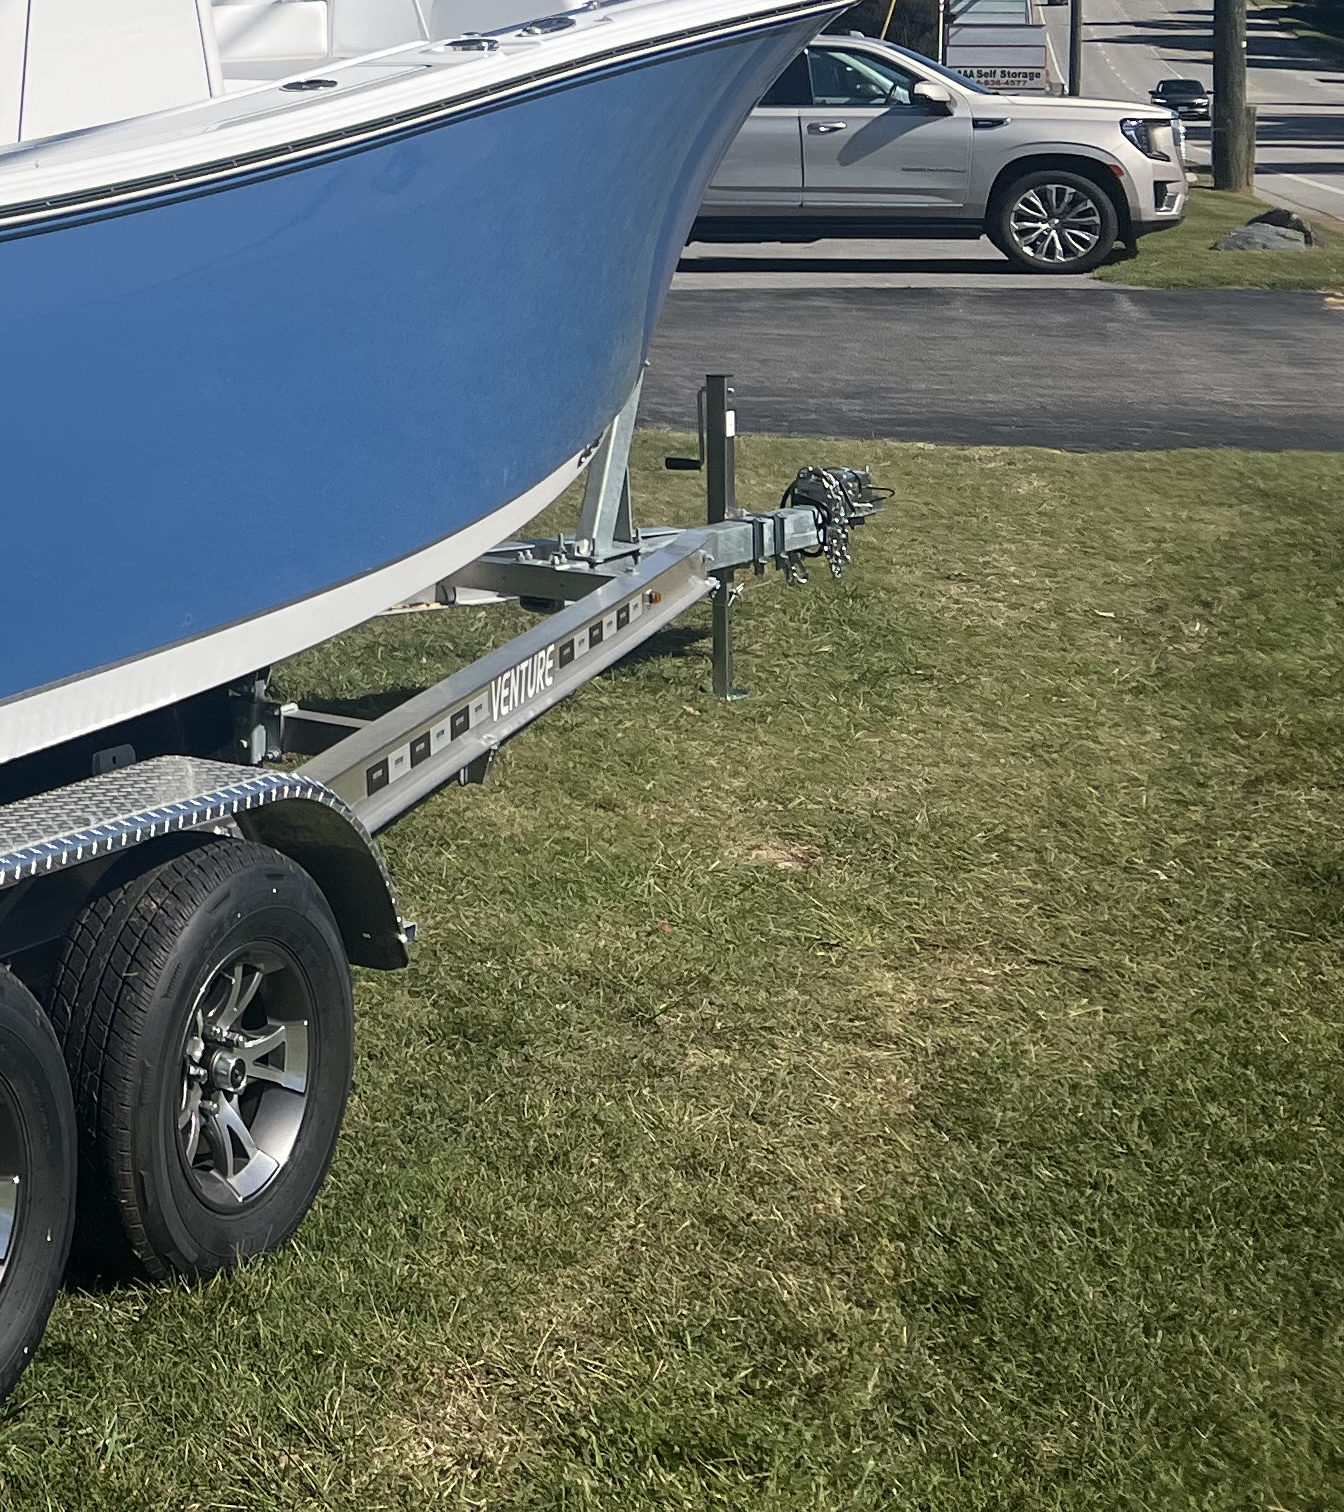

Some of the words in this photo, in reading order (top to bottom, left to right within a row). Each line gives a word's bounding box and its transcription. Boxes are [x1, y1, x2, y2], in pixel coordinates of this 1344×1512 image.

[976, 69, 997, 79] Self
[999, 69, 1041, 81] Storage
[490, 643, 555, 722] VENTURE
